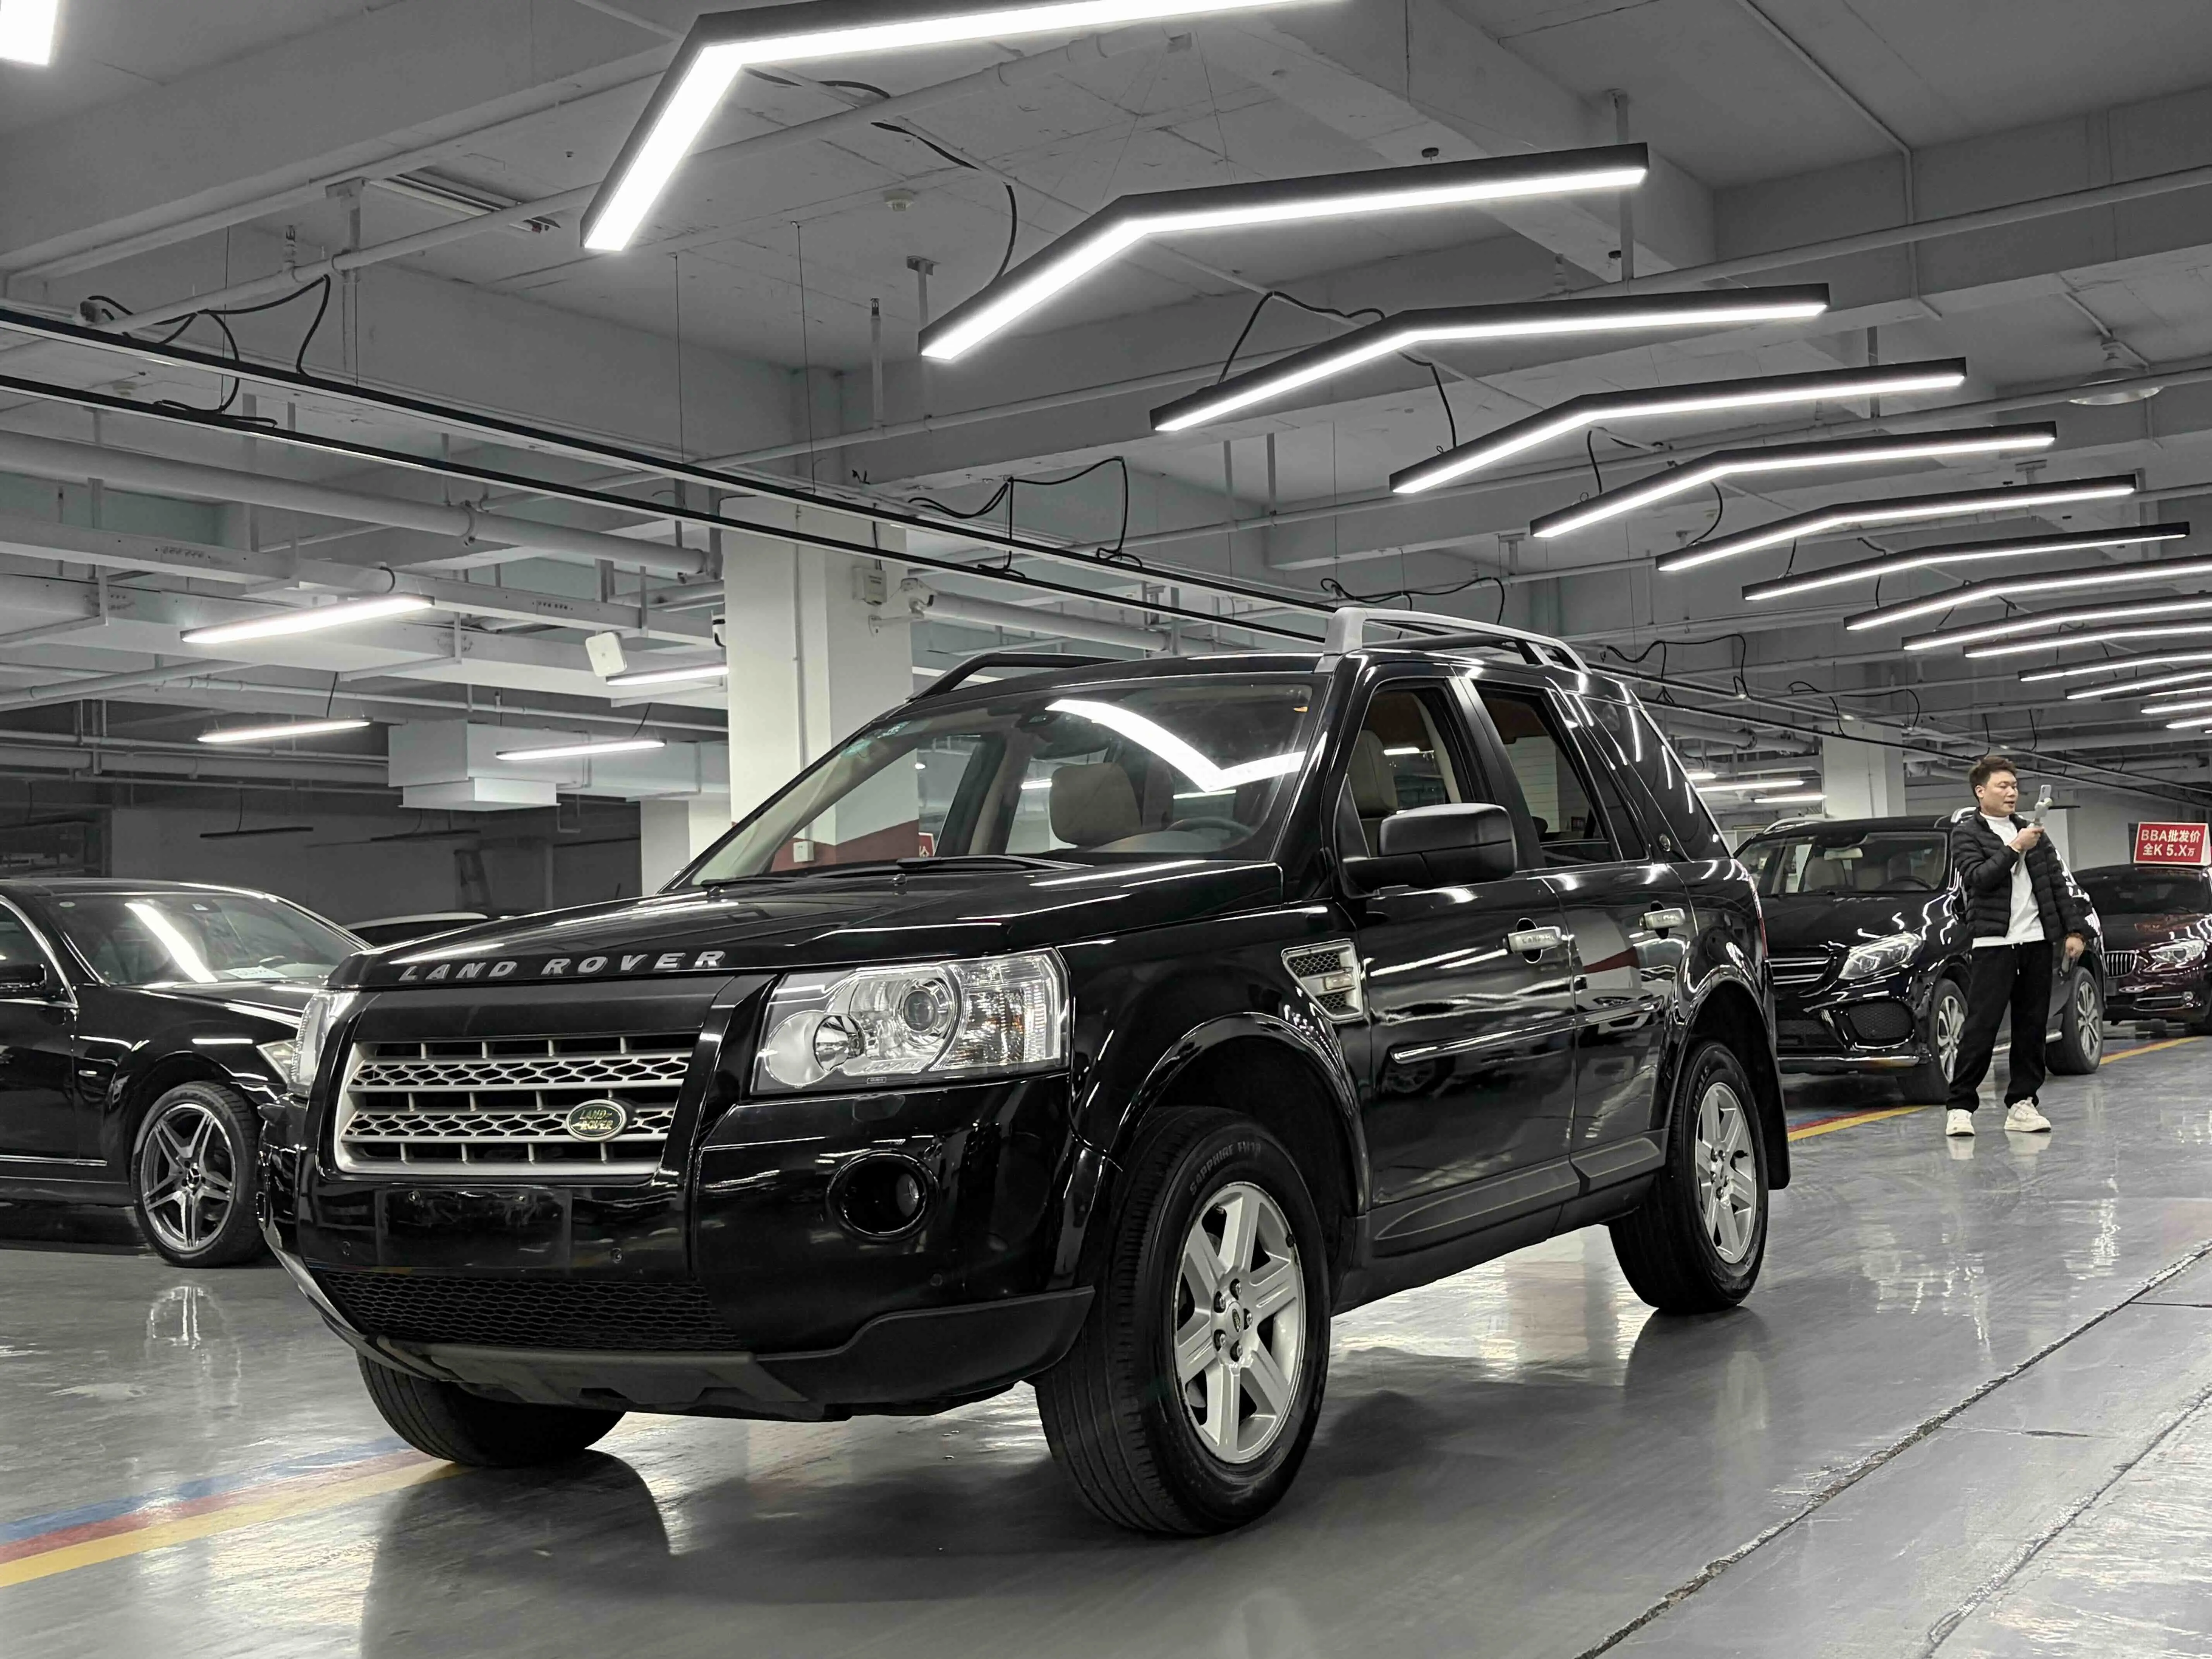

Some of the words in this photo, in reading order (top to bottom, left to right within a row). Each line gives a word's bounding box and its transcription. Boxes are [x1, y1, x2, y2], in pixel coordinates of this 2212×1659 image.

[2141, 829, 2201, 843] BBA批发价
[398, 961, 518, 982] LAND
[541, 950, 726, 976] ROVER
[1190, 1144, 1234, 1195] SAPPHIRE
